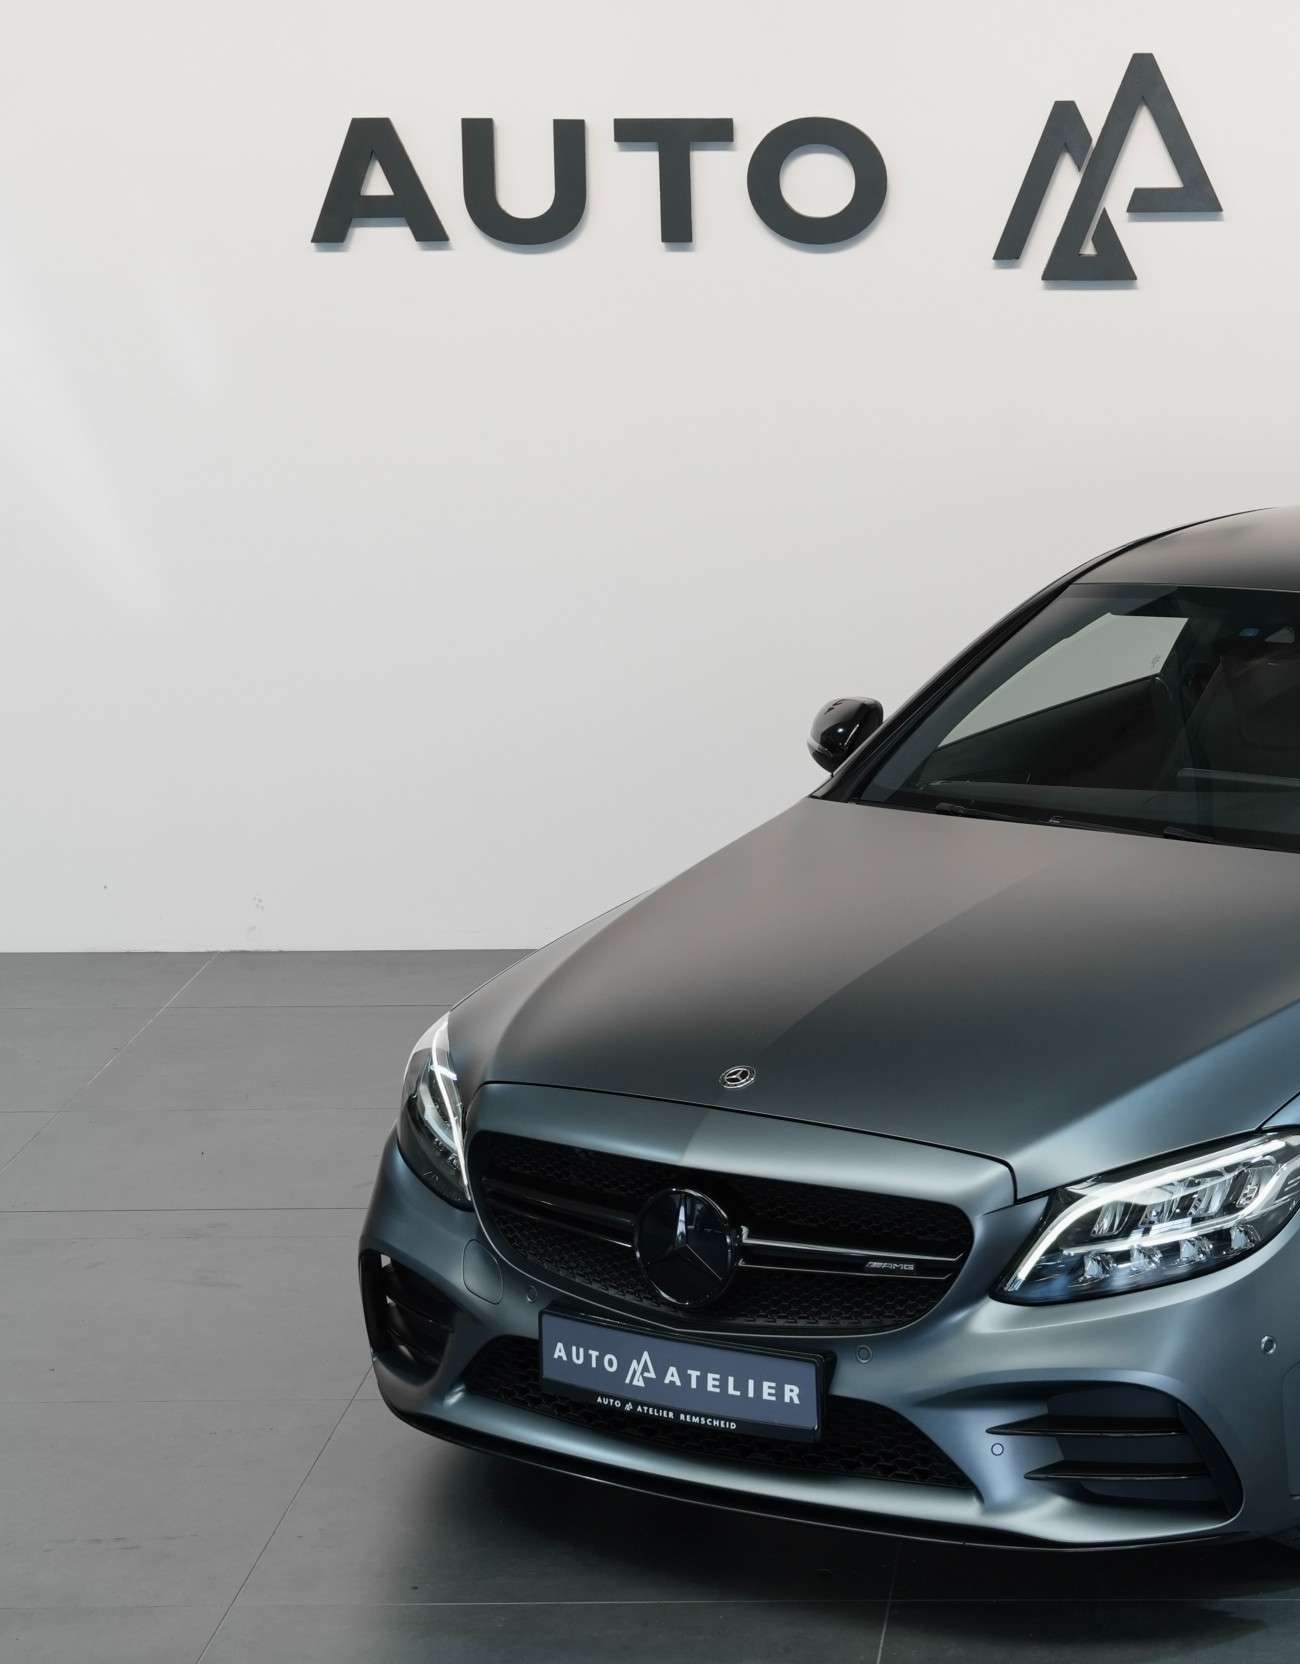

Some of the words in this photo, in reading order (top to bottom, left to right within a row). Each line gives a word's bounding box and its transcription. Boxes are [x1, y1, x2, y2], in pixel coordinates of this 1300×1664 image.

[311, 116, 888, 246] AUTO
[880, 1262, 915, 1271] AMG
[553, 1342, 618, 1372] AUTO
[663, 1366, 800, 1404] ATELIER
[596, 1396, 621, 1408] AUTO
[636, 1405, 674, 1419] ATELIER
[679, 1413, 737, 1430] REMSCHEID
